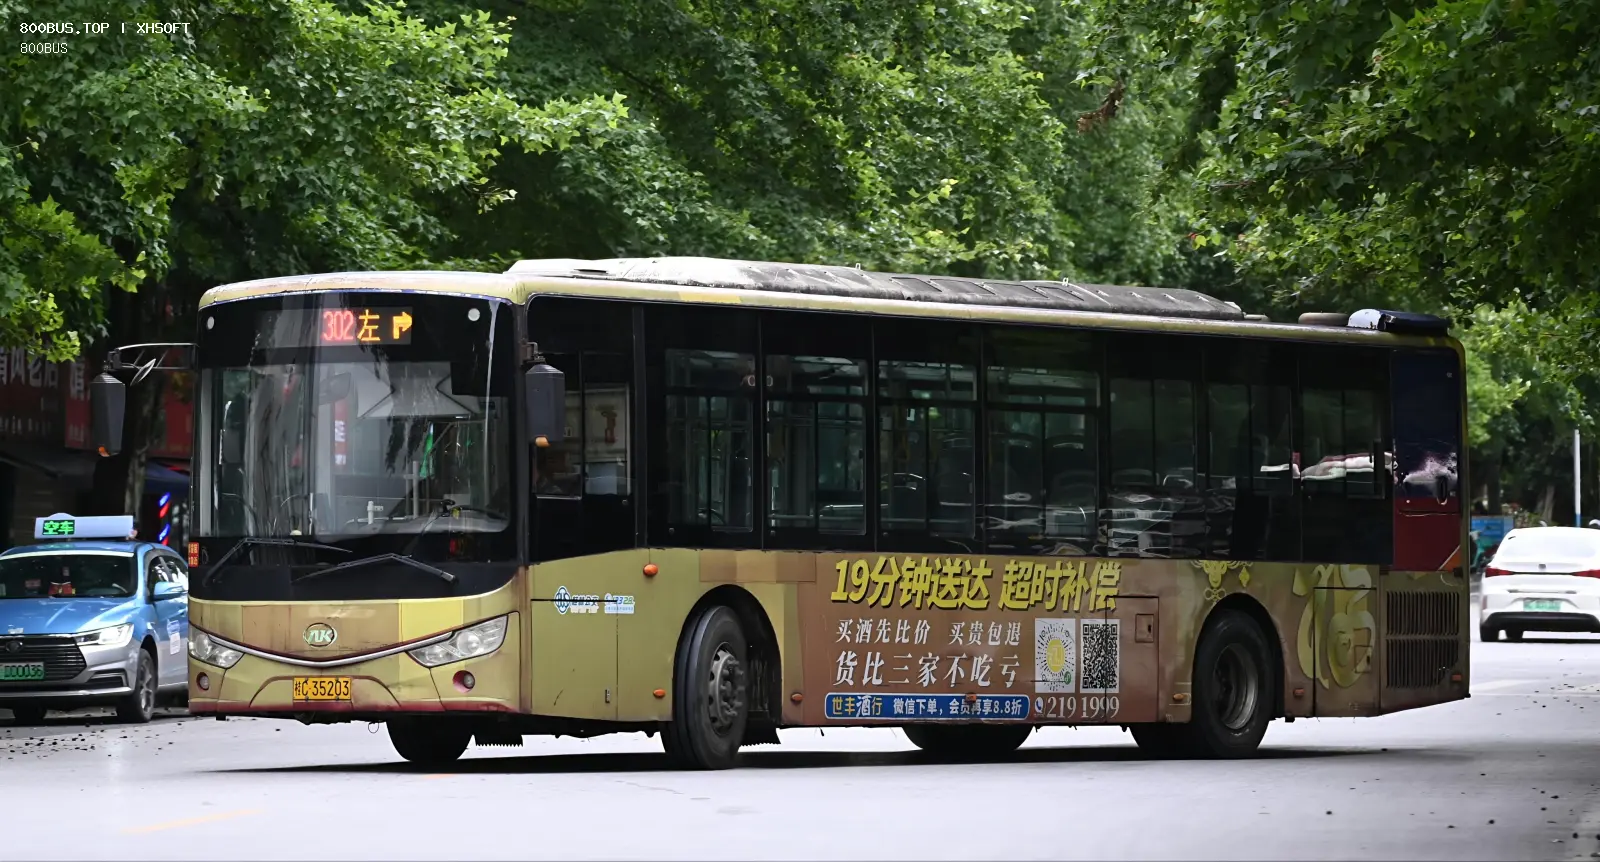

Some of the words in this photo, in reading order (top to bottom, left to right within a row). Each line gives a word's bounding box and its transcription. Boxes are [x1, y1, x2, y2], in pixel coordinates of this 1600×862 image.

[323, 310, 354, 341] 302
[357, 309, 381, 341] 左
[43, 521, 74, 535] 空车
[830, 555, 993, 609] 19分钟送达
[998, 559, 1122, 611] 超时补偿
[836, 618, 931, 645] 买酒先比价
[949, 620, 1021, 646] 买贵包退
[833, 650, 1020, 688] 货比三家不吃亏
[832, 695, 883, 717] 世丰酒行
[1046, 696, 1077, 718] 219
[1081, 696, 1120, 718] 1999
